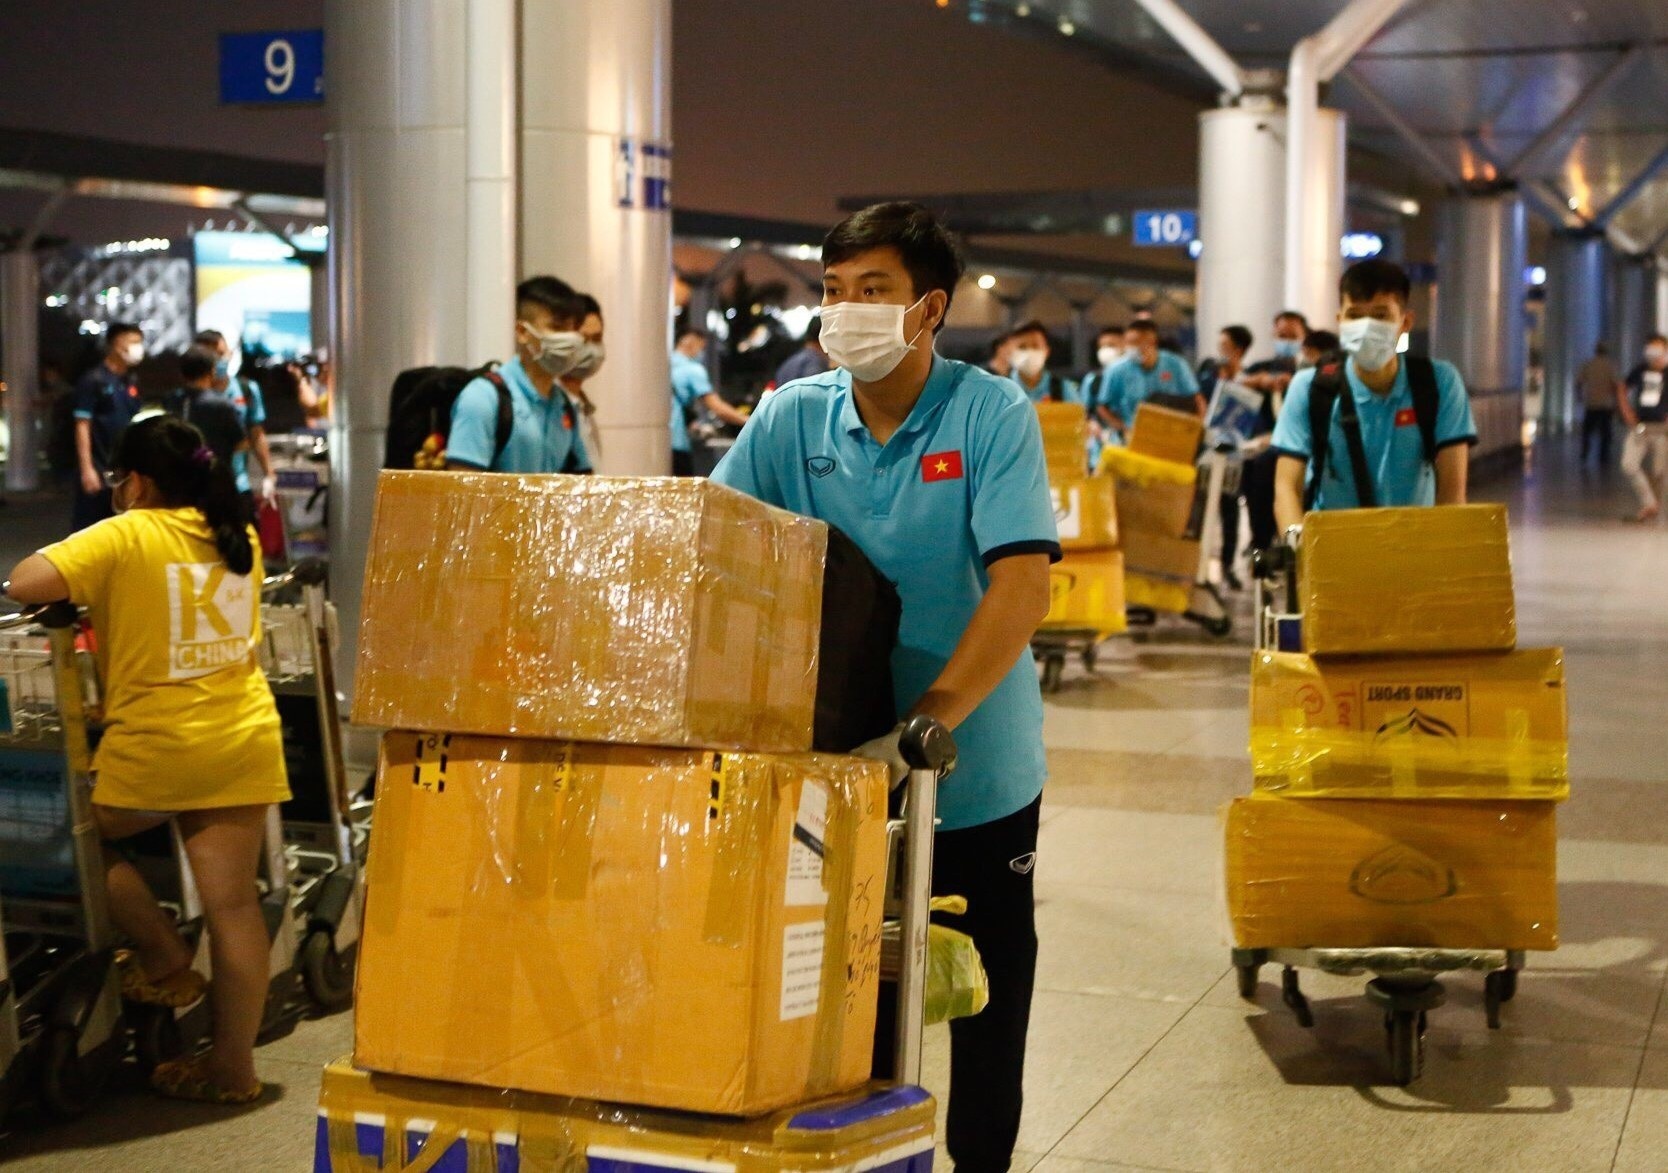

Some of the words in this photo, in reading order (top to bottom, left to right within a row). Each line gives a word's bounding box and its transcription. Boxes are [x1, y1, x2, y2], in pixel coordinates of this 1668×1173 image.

[265, 40, 294, 94] 9
[1147, 213, 1182, 243] 10
[178, 564, 234, 641] K
[1368, 685, 1411, 701] SPORT
[1415, 685, 1463, 701] GRAND
